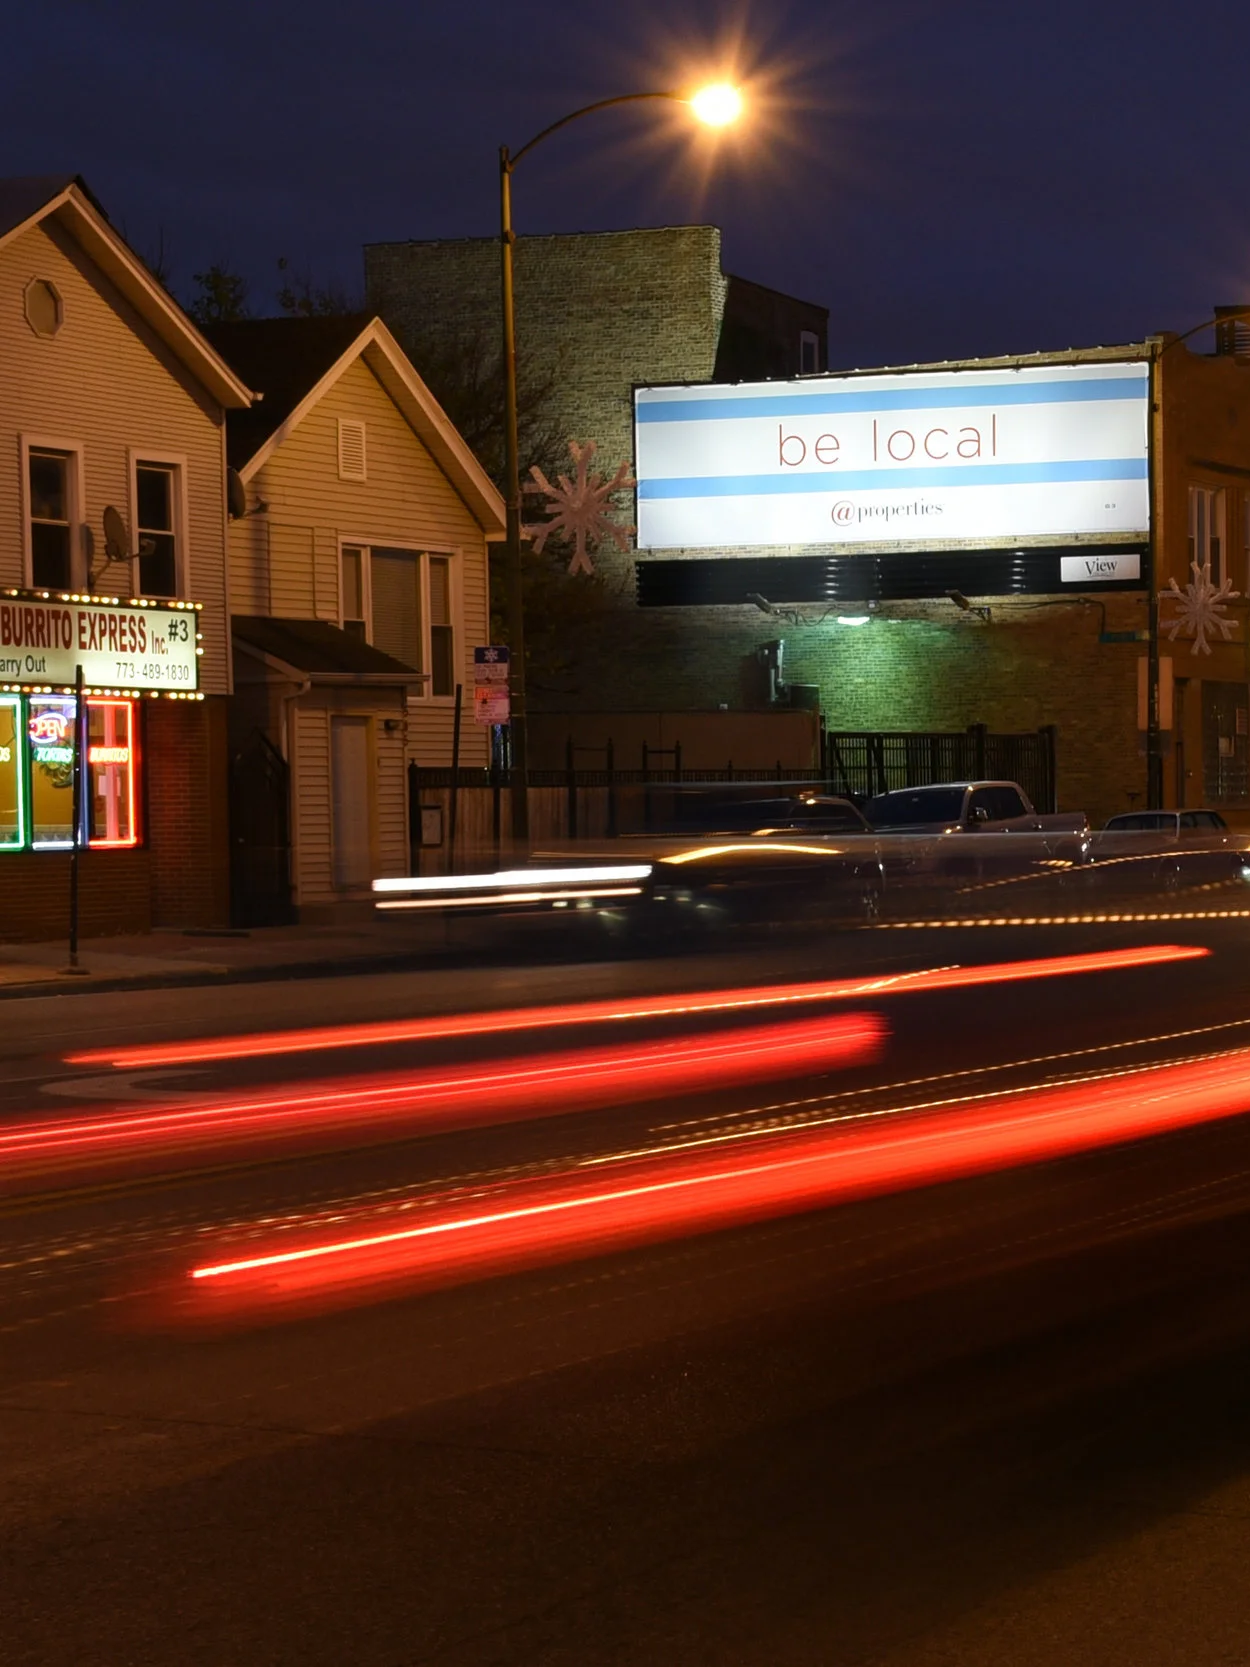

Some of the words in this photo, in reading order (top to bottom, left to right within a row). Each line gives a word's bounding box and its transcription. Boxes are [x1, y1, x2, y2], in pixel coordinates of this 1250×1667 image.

[779, 424, 840, 466] be
[873, 413, 996, 462] local
[831, 498, 944, 527] @properties
[1085, 557, 1118, 576] View
[1, 605, 73, 650] BURRITO
[78, 611, 147, 654] EXPRESS
[152, 630, 169, 655] Inc.
[168, 618, 189, 642] #3
[0, 658, 22, 677] arry
[25, 655, 46, 673] Out
